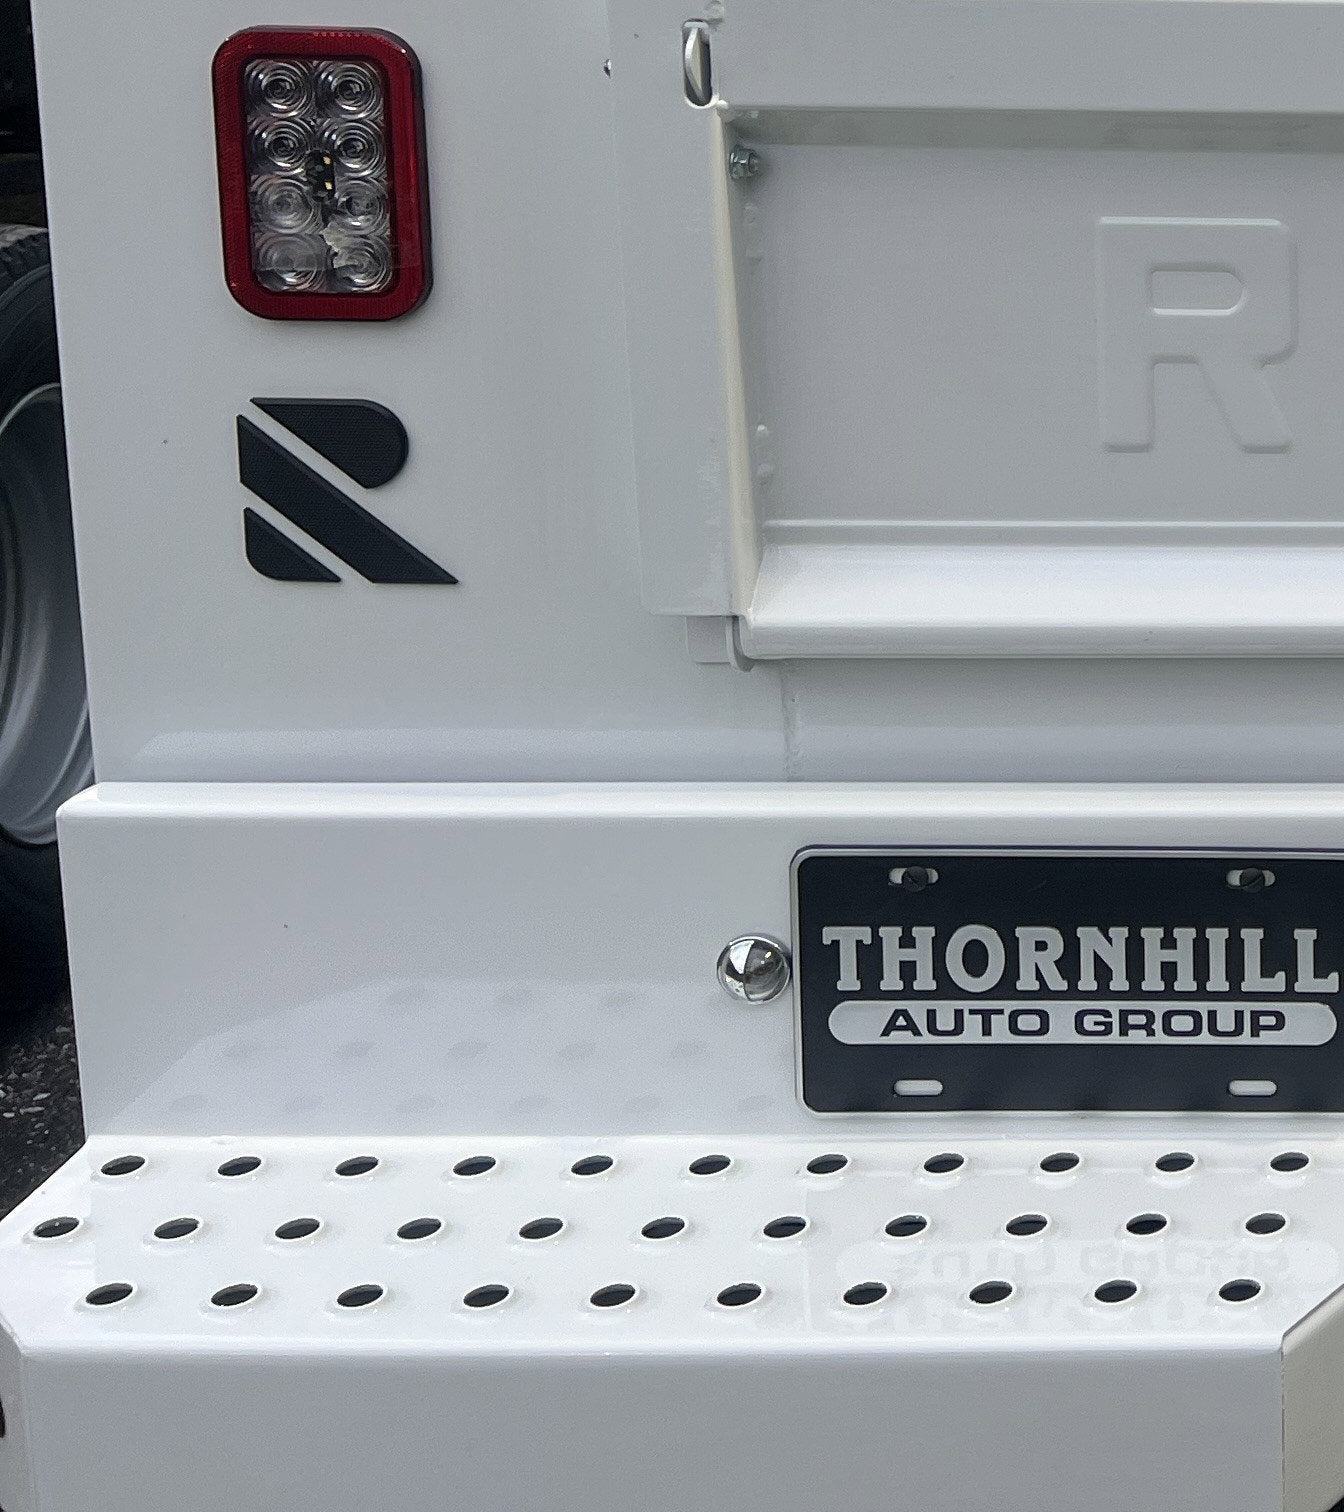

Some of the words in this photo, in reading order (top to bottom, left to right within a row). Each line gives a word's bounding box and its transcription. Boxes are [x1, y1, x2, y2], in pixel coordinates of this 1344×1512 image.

[821, 923, 1341, 994] THORNHILL
[879, 1007, 1052, 1038] AUTO
[1073, 1007, 1287, 1039] GROUP
